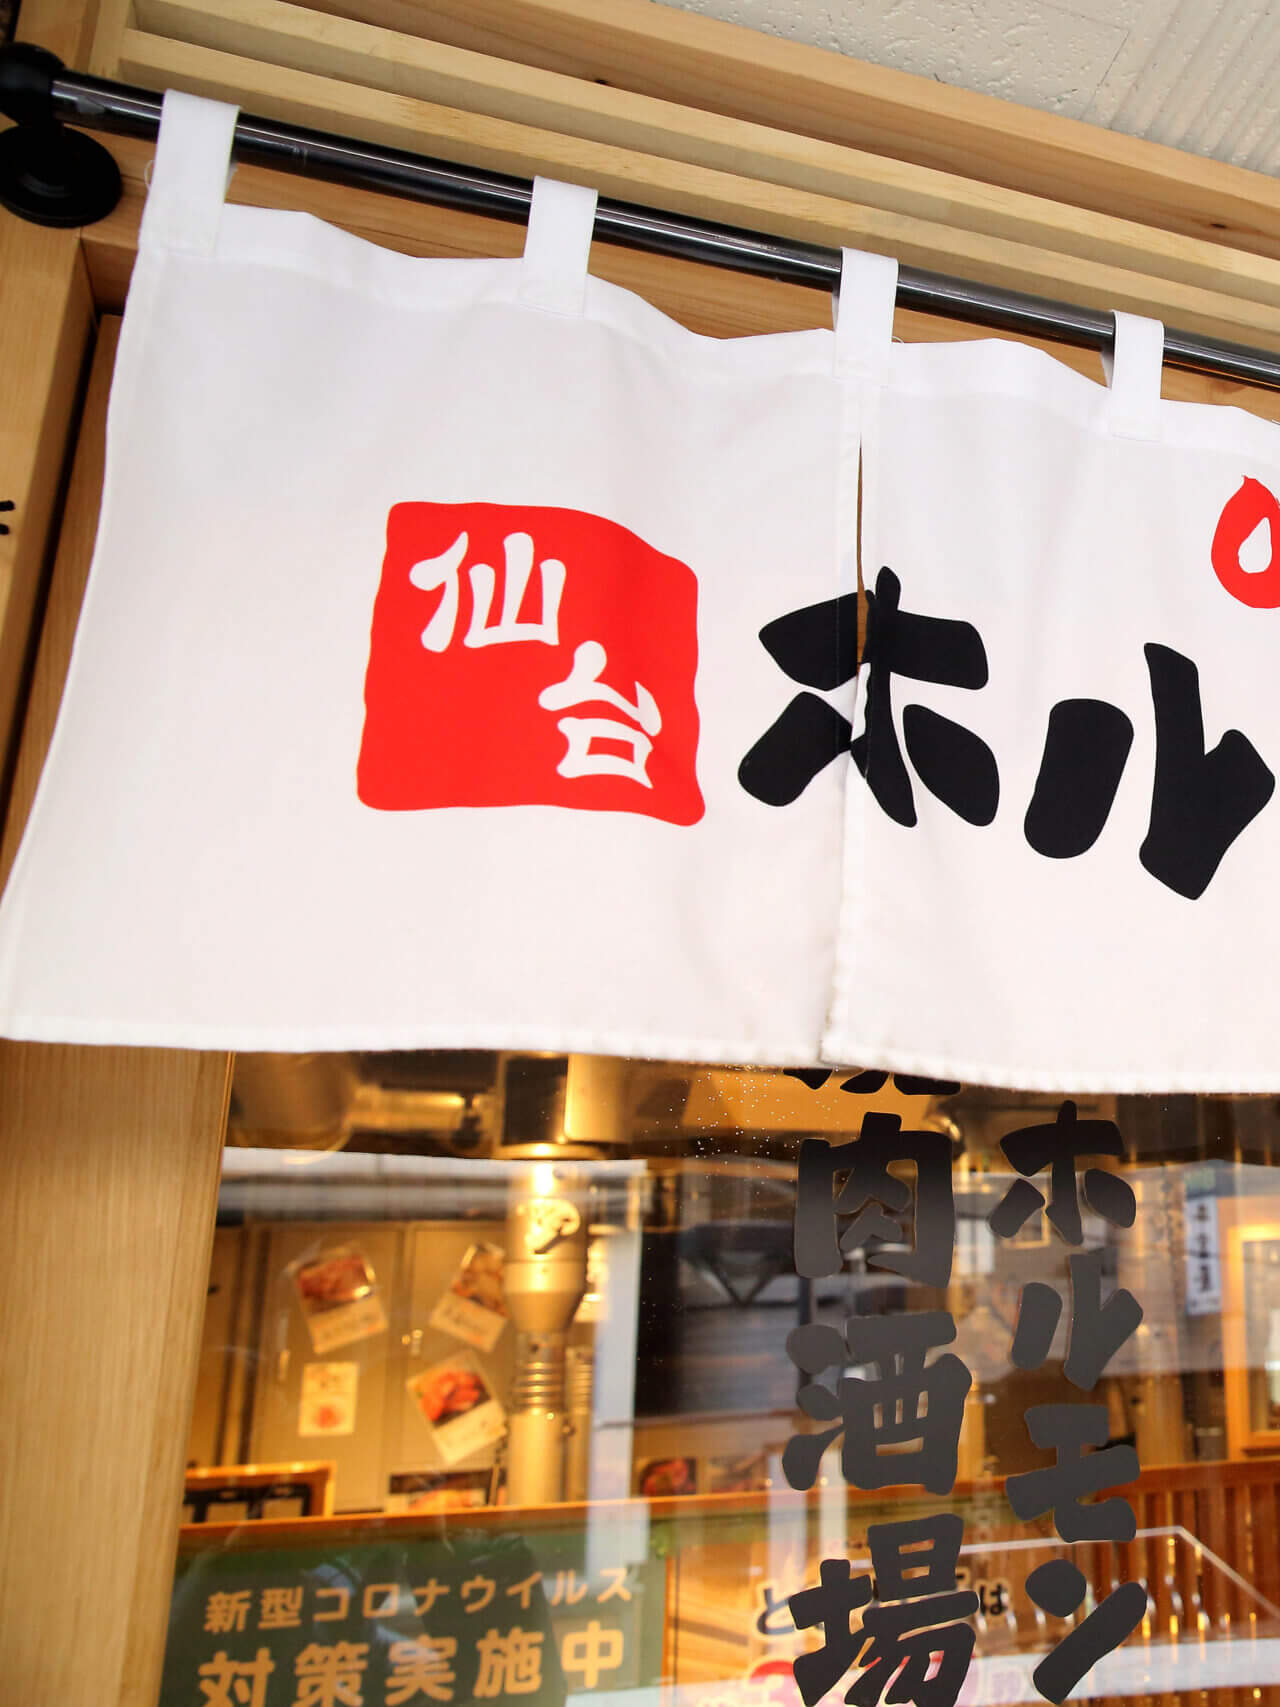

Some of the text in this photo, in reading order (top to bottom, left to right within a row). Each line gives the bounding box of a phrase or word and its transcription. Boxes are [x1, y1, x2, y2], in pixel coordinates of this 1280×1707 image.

[408, 531, 663, 789] 仙台
[781, 1067, 981, 1707] 肉酒場
[990, 1100, 1149, 1705] ホルモン
[197, 1620, 625, 1707] 対策実施中
[203, 1566, 633, 1634] 新型コロナウイルス
